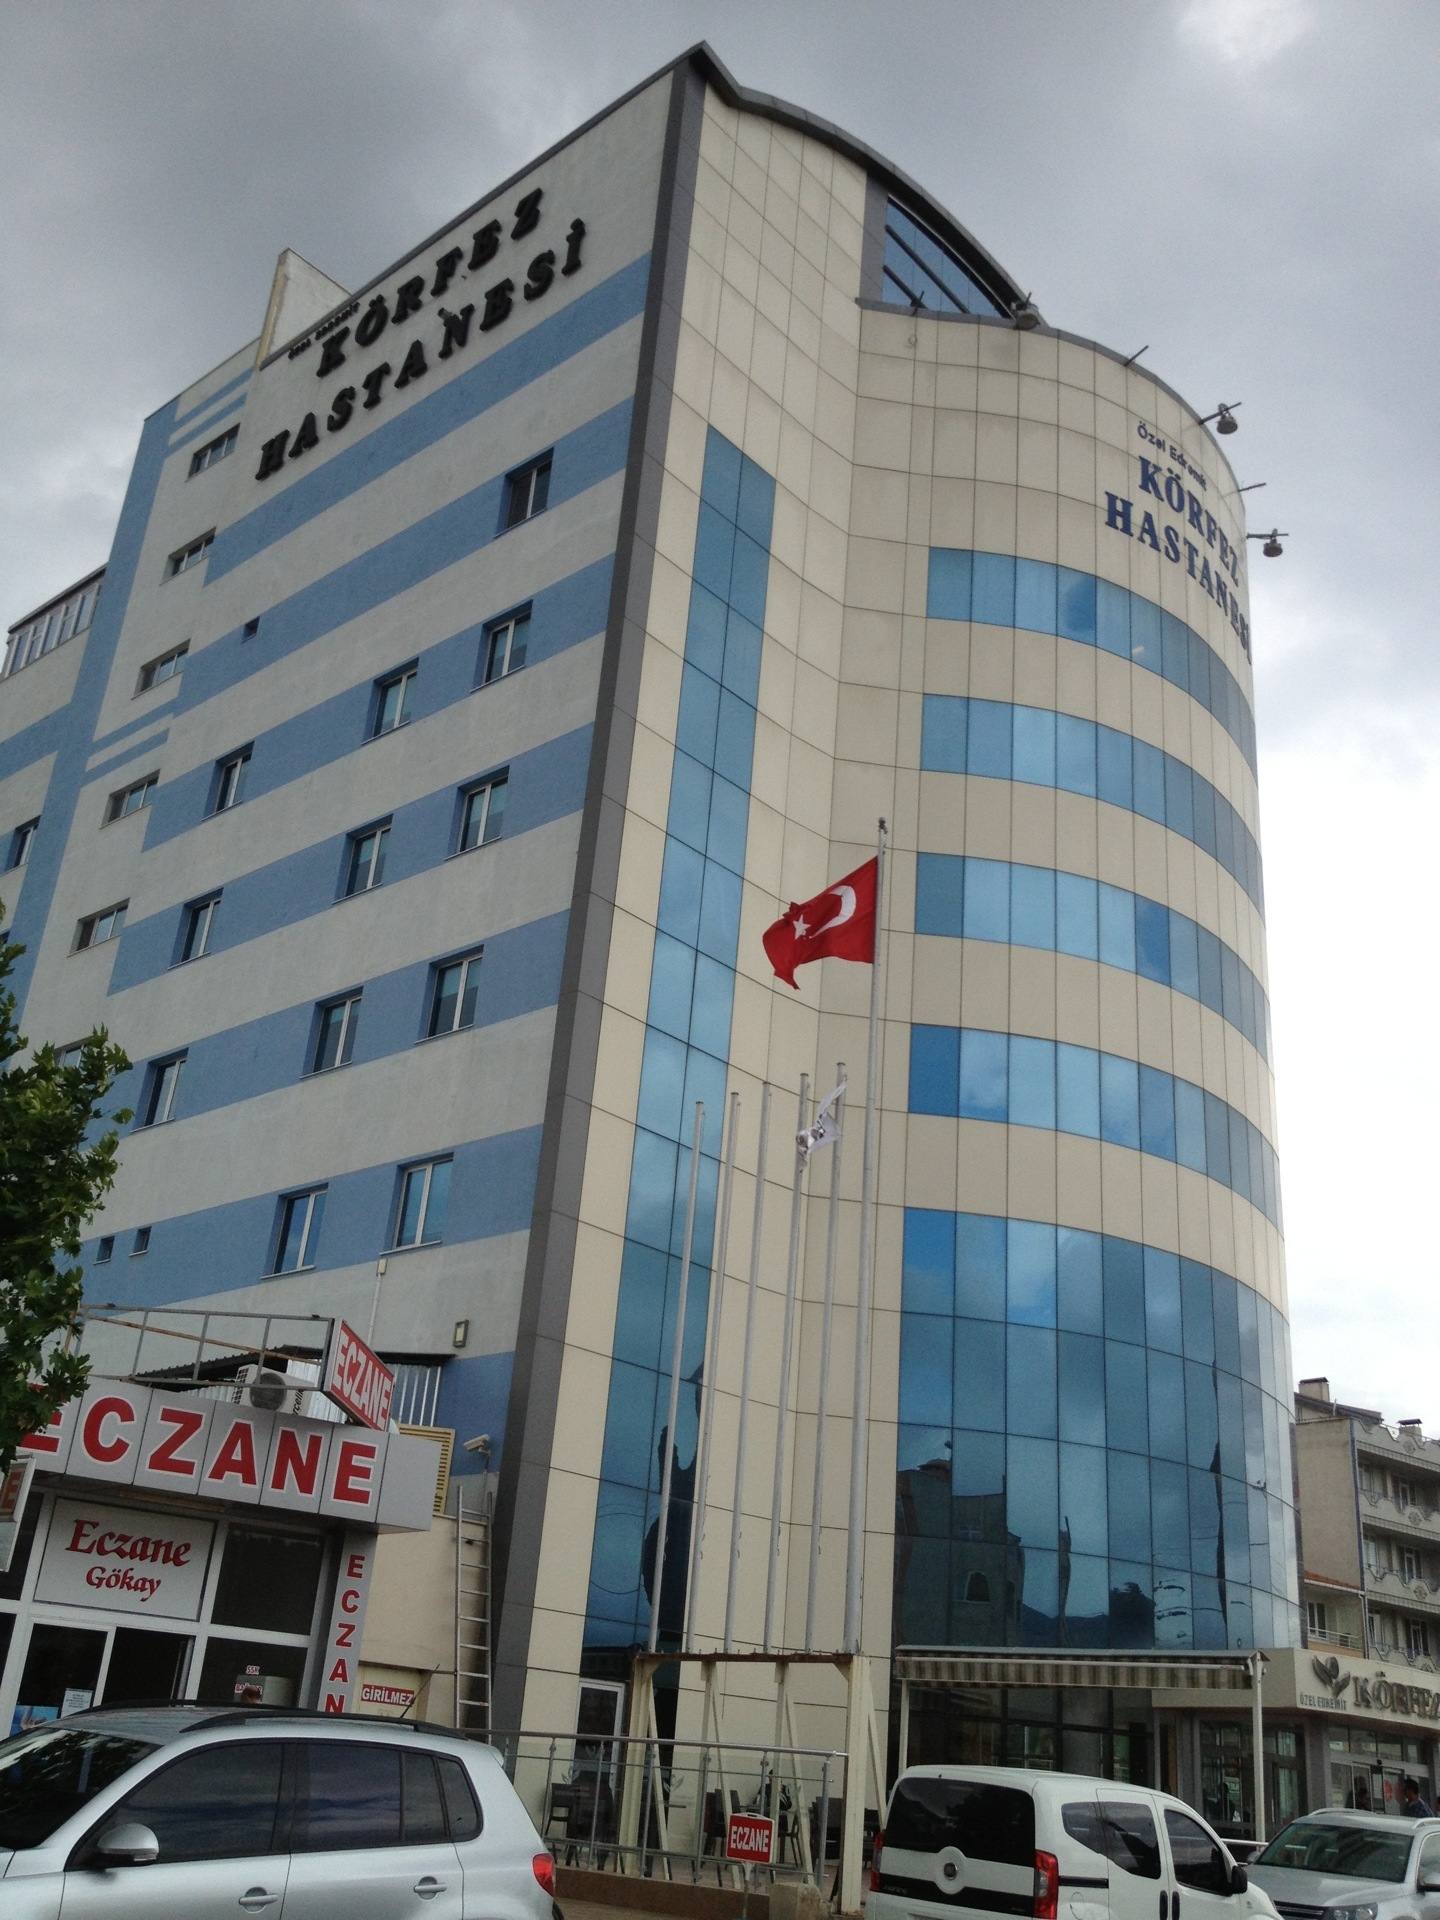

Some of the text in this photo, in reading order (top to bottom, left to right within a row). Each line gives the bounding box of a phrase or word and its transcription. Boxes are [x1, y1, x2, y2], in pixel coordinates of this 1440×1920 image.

[317, 188, 544, 378] KÖRFEZ
[255, 217, 586, 480] HASTANESİ
[1137, 420, 1166, 453] Özel
[1138, 456, 1239, 588] KÖRFEZ
[331, 1329, 392, 1430] ECZANE
[65, 1519, 191, 1567] Eczane
[86, 1566, 161, 1602] Gökay
[362, 1686, 413, 1706] GİRİLMEZ
[730, 1825, 770, 1853] ECZANE
